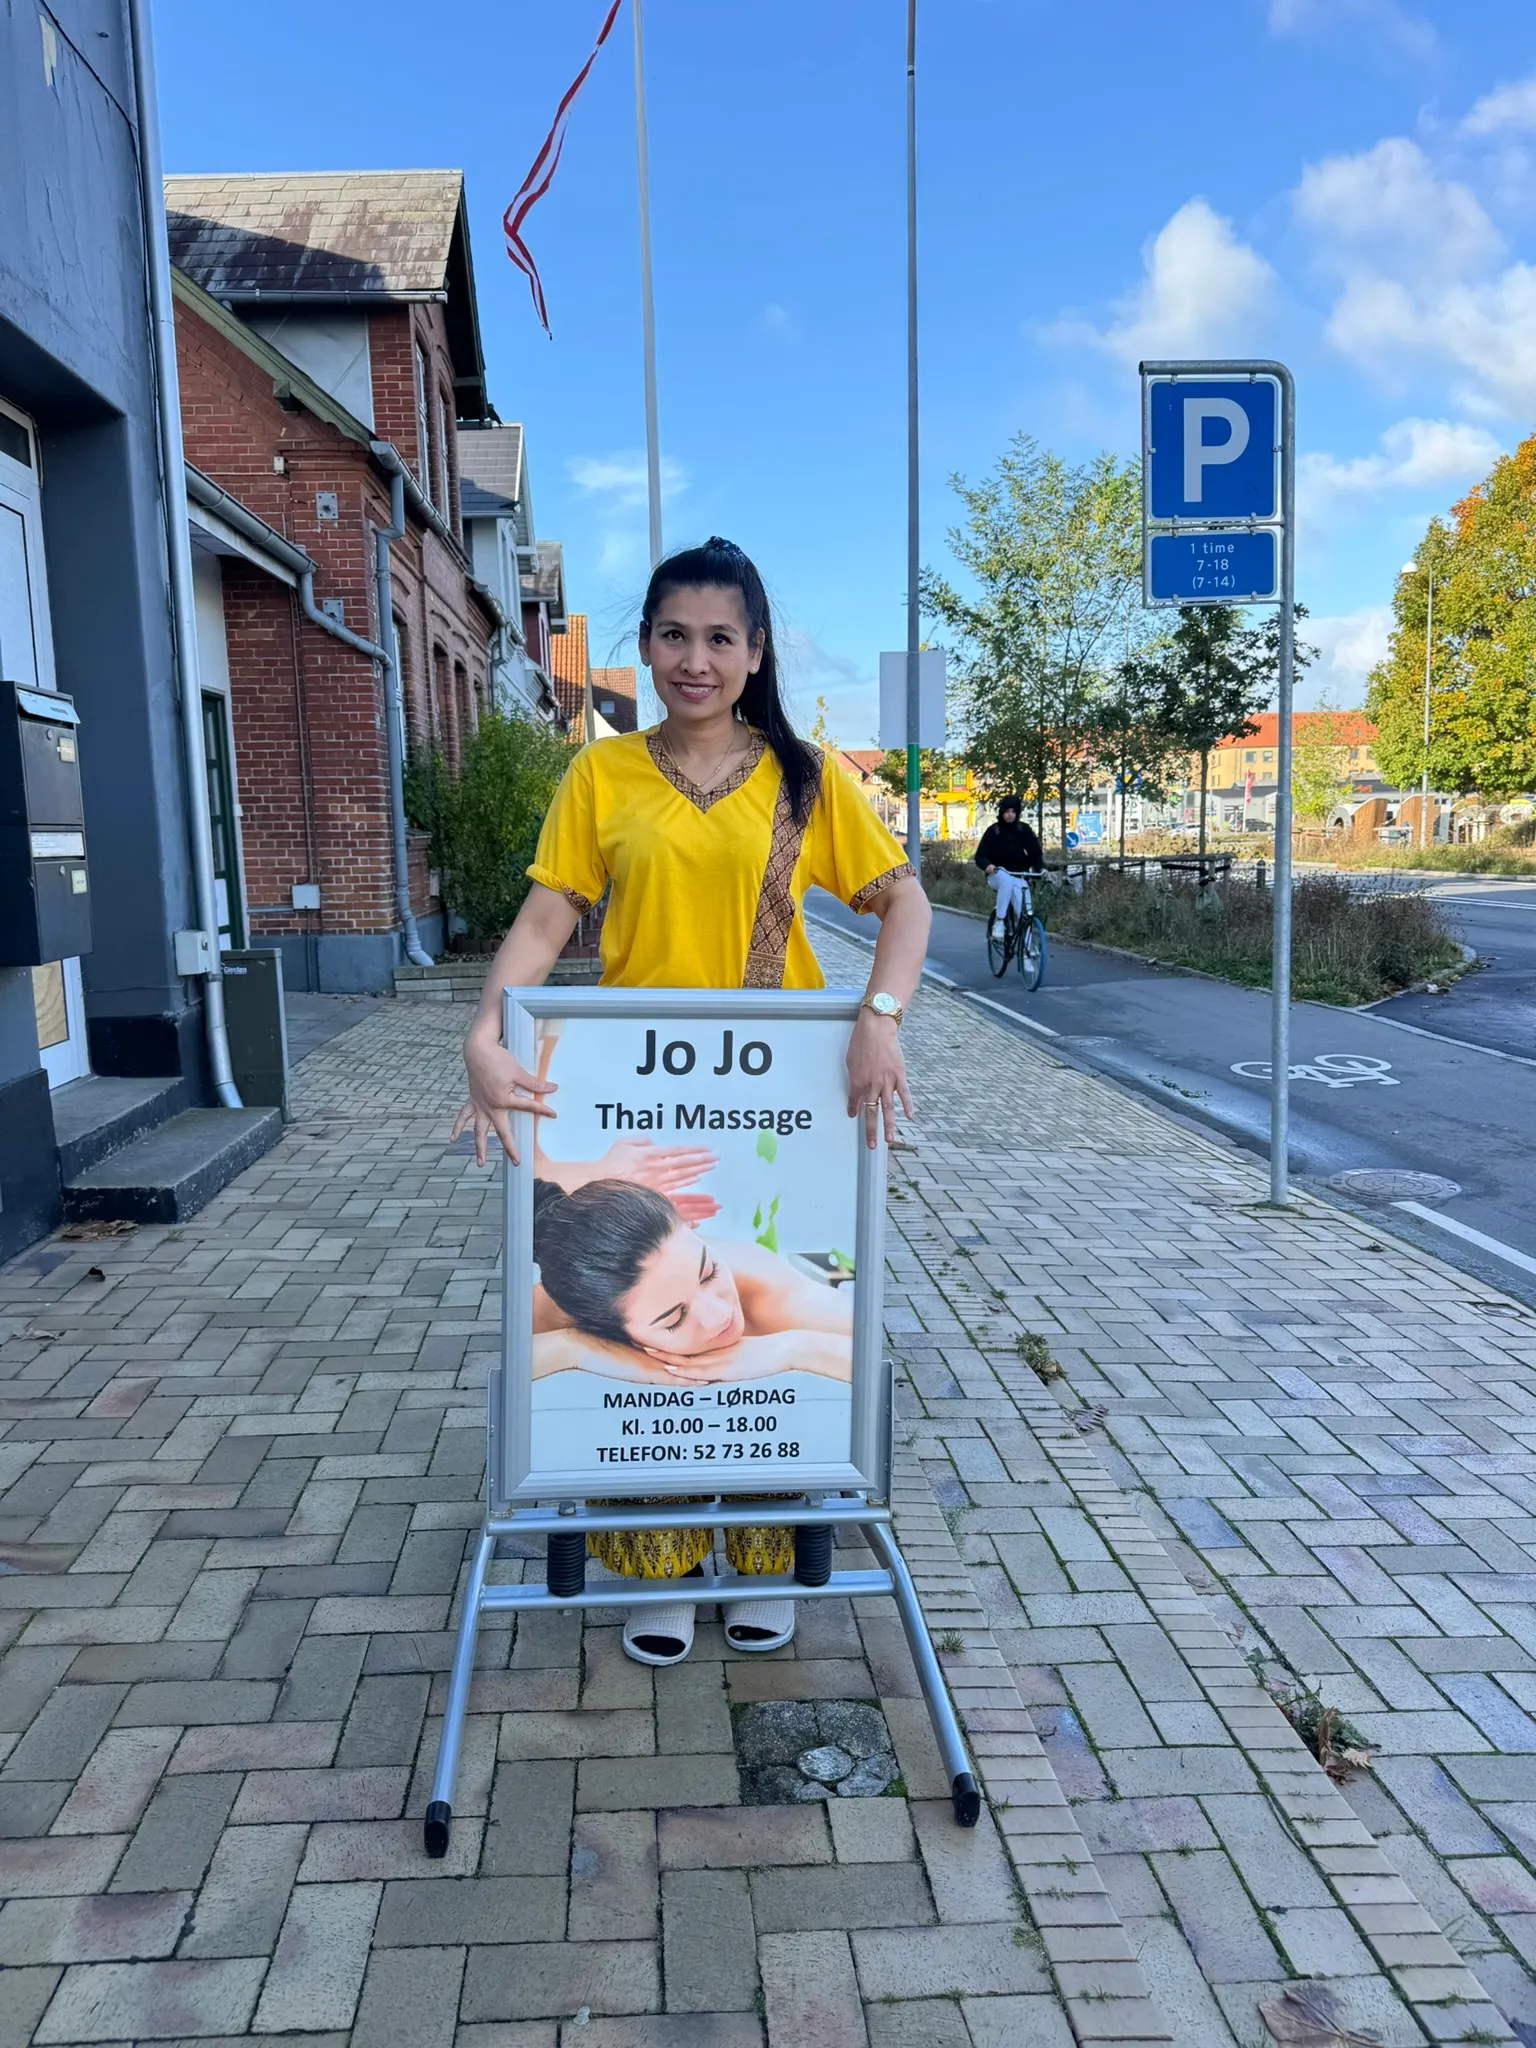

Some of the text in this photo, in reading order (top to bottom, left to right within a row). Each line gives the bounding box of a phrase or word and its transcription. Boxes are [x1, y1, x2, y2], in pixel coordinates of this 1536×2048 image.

[1183, 397, 1251, 503] P
[1190, 542, 1235, 554] 1 time
[1196, 558, 1229, 571] 7-18
[1192, 574, 1236, 589] (7-14)
[636, 1029, 773, 1076] Jo Jo
[595, 1102, 813, 1136] Thai Massage
[603, 1390, 694, 1409] MANDAG
[717, 1387, 796, 1408] LØRDAG
[622, 1418, 645, 1436] Kl.
[651, 1417, 704, 1435] 10.00
[726, 1415, 777, 1433] 18.00
[596, 1441, 800, 1463] TELEFON: 52 73 26 88
